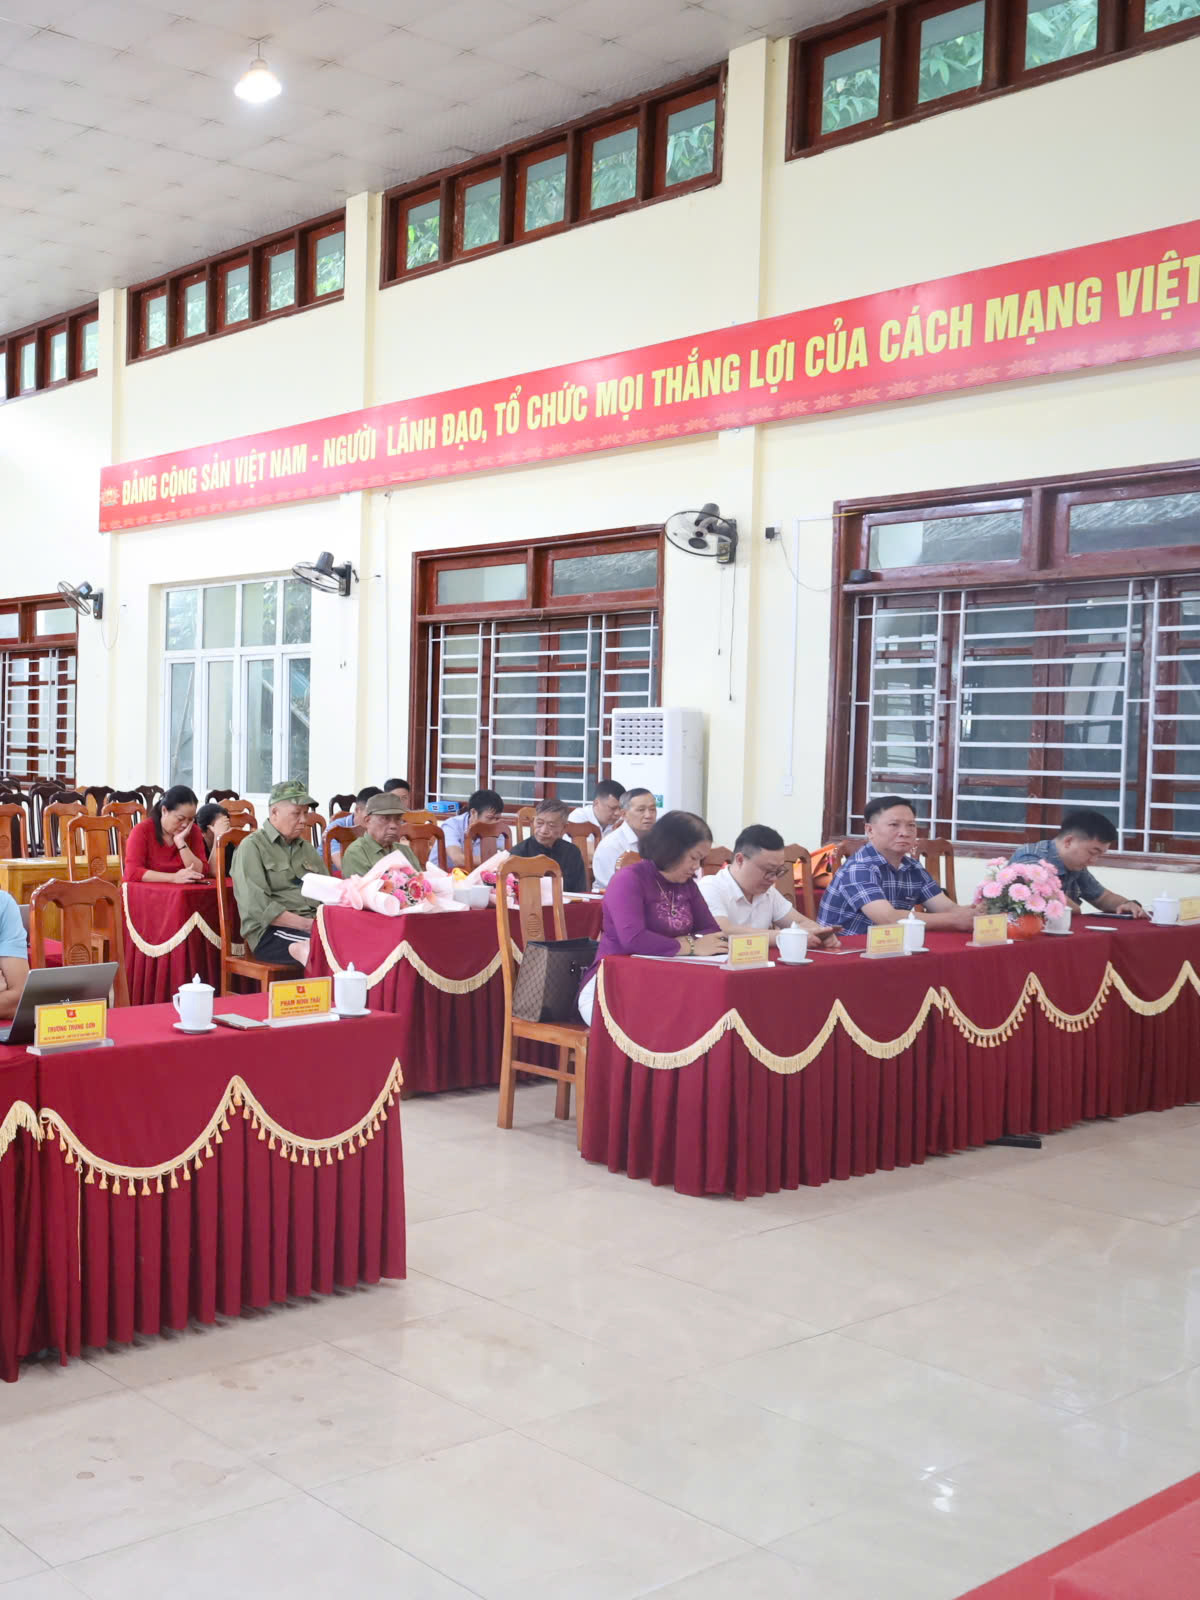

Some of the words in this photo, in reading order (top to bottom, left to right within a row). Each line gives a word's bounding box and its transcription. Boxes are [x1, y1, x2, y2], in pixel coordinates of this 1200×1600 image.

[122, 469, 158, 505] ĐẢNG
[160, 465, 199, 503] CỘNG
[201, 453, 231, 491] SẢN
[234, 448, 267, 488] VIỆT
[269, 444, 308, 479] NAM
[322, 424, 378, 469] NGƯỜI
[387, 417, 437, 456] LÃNH
[441, 407, 488, 451] ĐẠO,
[494, 385, 522, 436] TỔ
[527, 381, 590, 430] CHỨC
[593, 374, 644, 421] MỌI
[651, 347, 742, 406] THẮNG
[749, 339, 796, 393] LỢI
[805, 317, 869, 377] CỦA
[880, 306, 973, 363] CÁCH
[984, 277, 1103, 345] MẠNG
[1117, 250, 1200, 320] VIỆT
